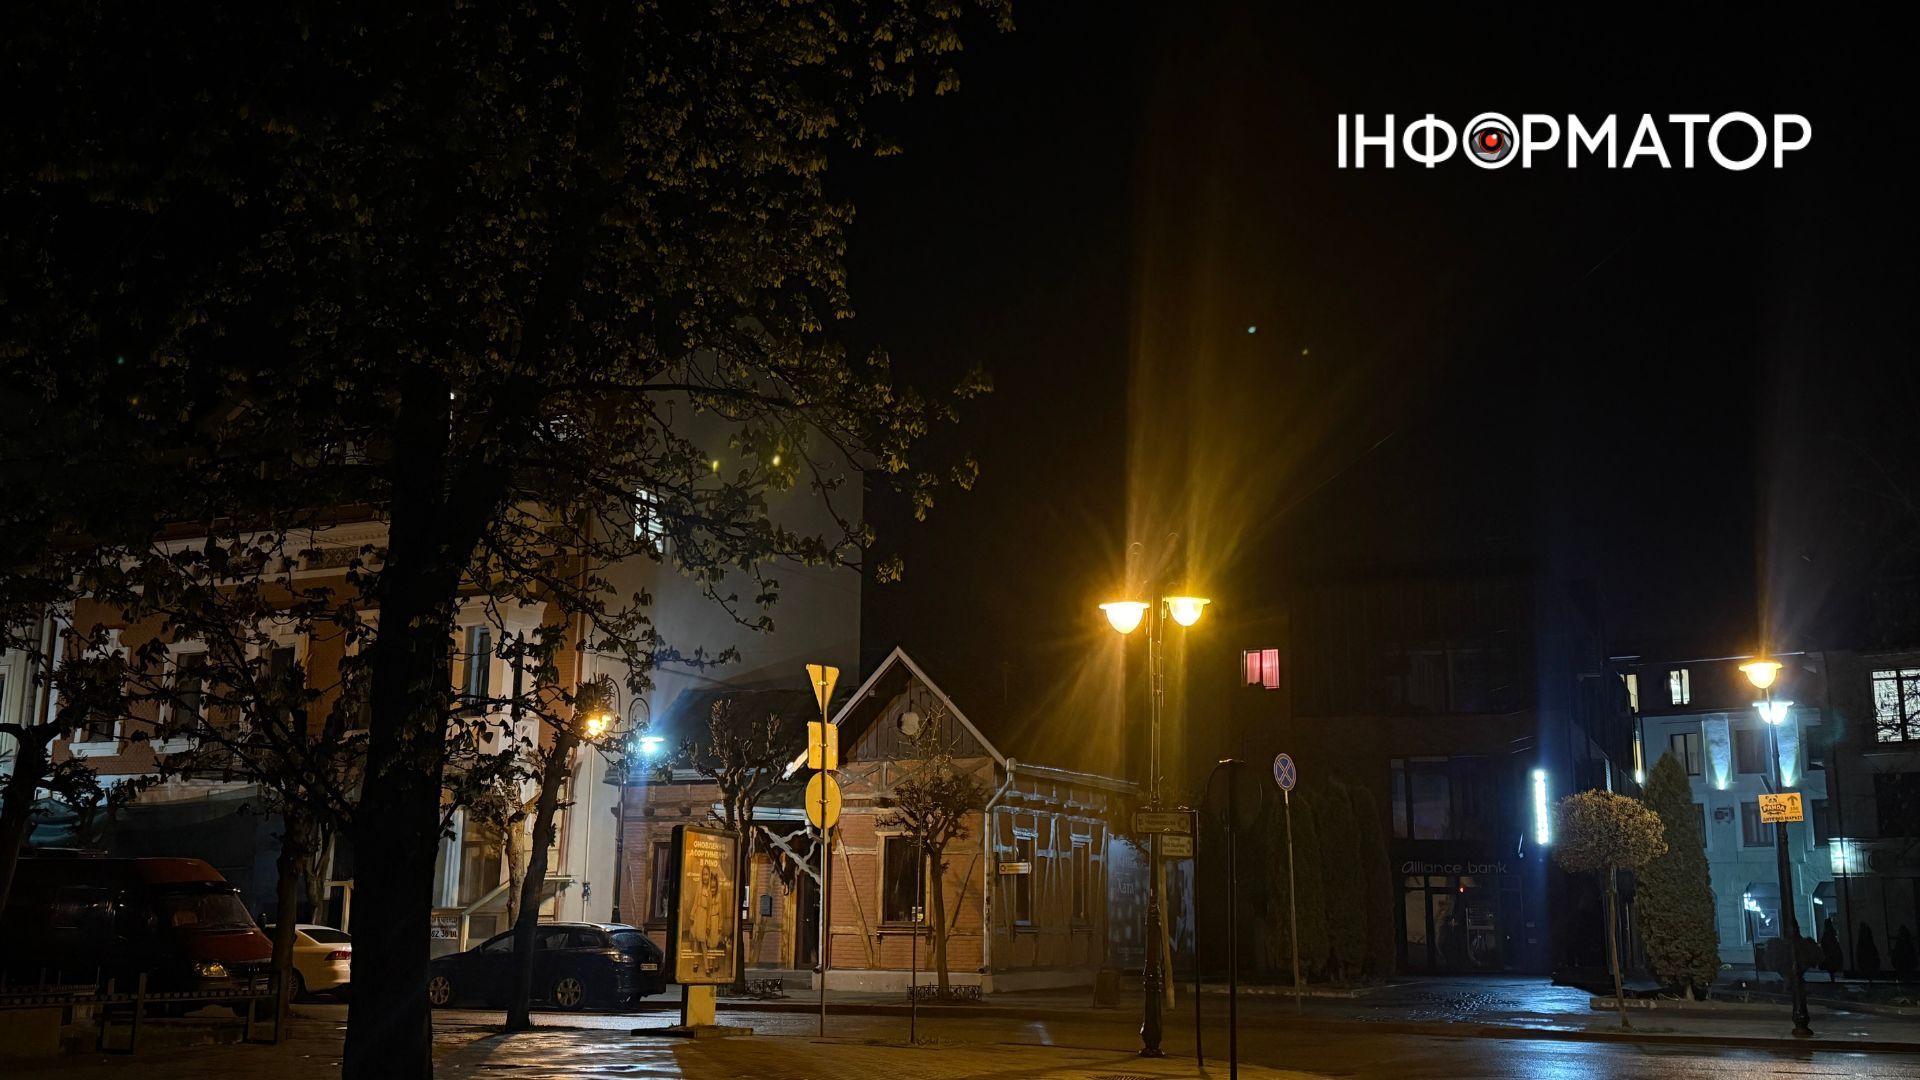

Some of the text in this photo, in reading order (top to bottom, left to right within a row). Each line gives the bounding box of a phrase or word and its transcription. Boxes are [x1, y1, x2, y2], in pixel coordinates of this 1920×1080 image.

[1763, 804, 1786, 812] PANDA
[689, 849, 728, 860] АСОРТИМЕУ
[1468, 860, 1507, 874] bank
